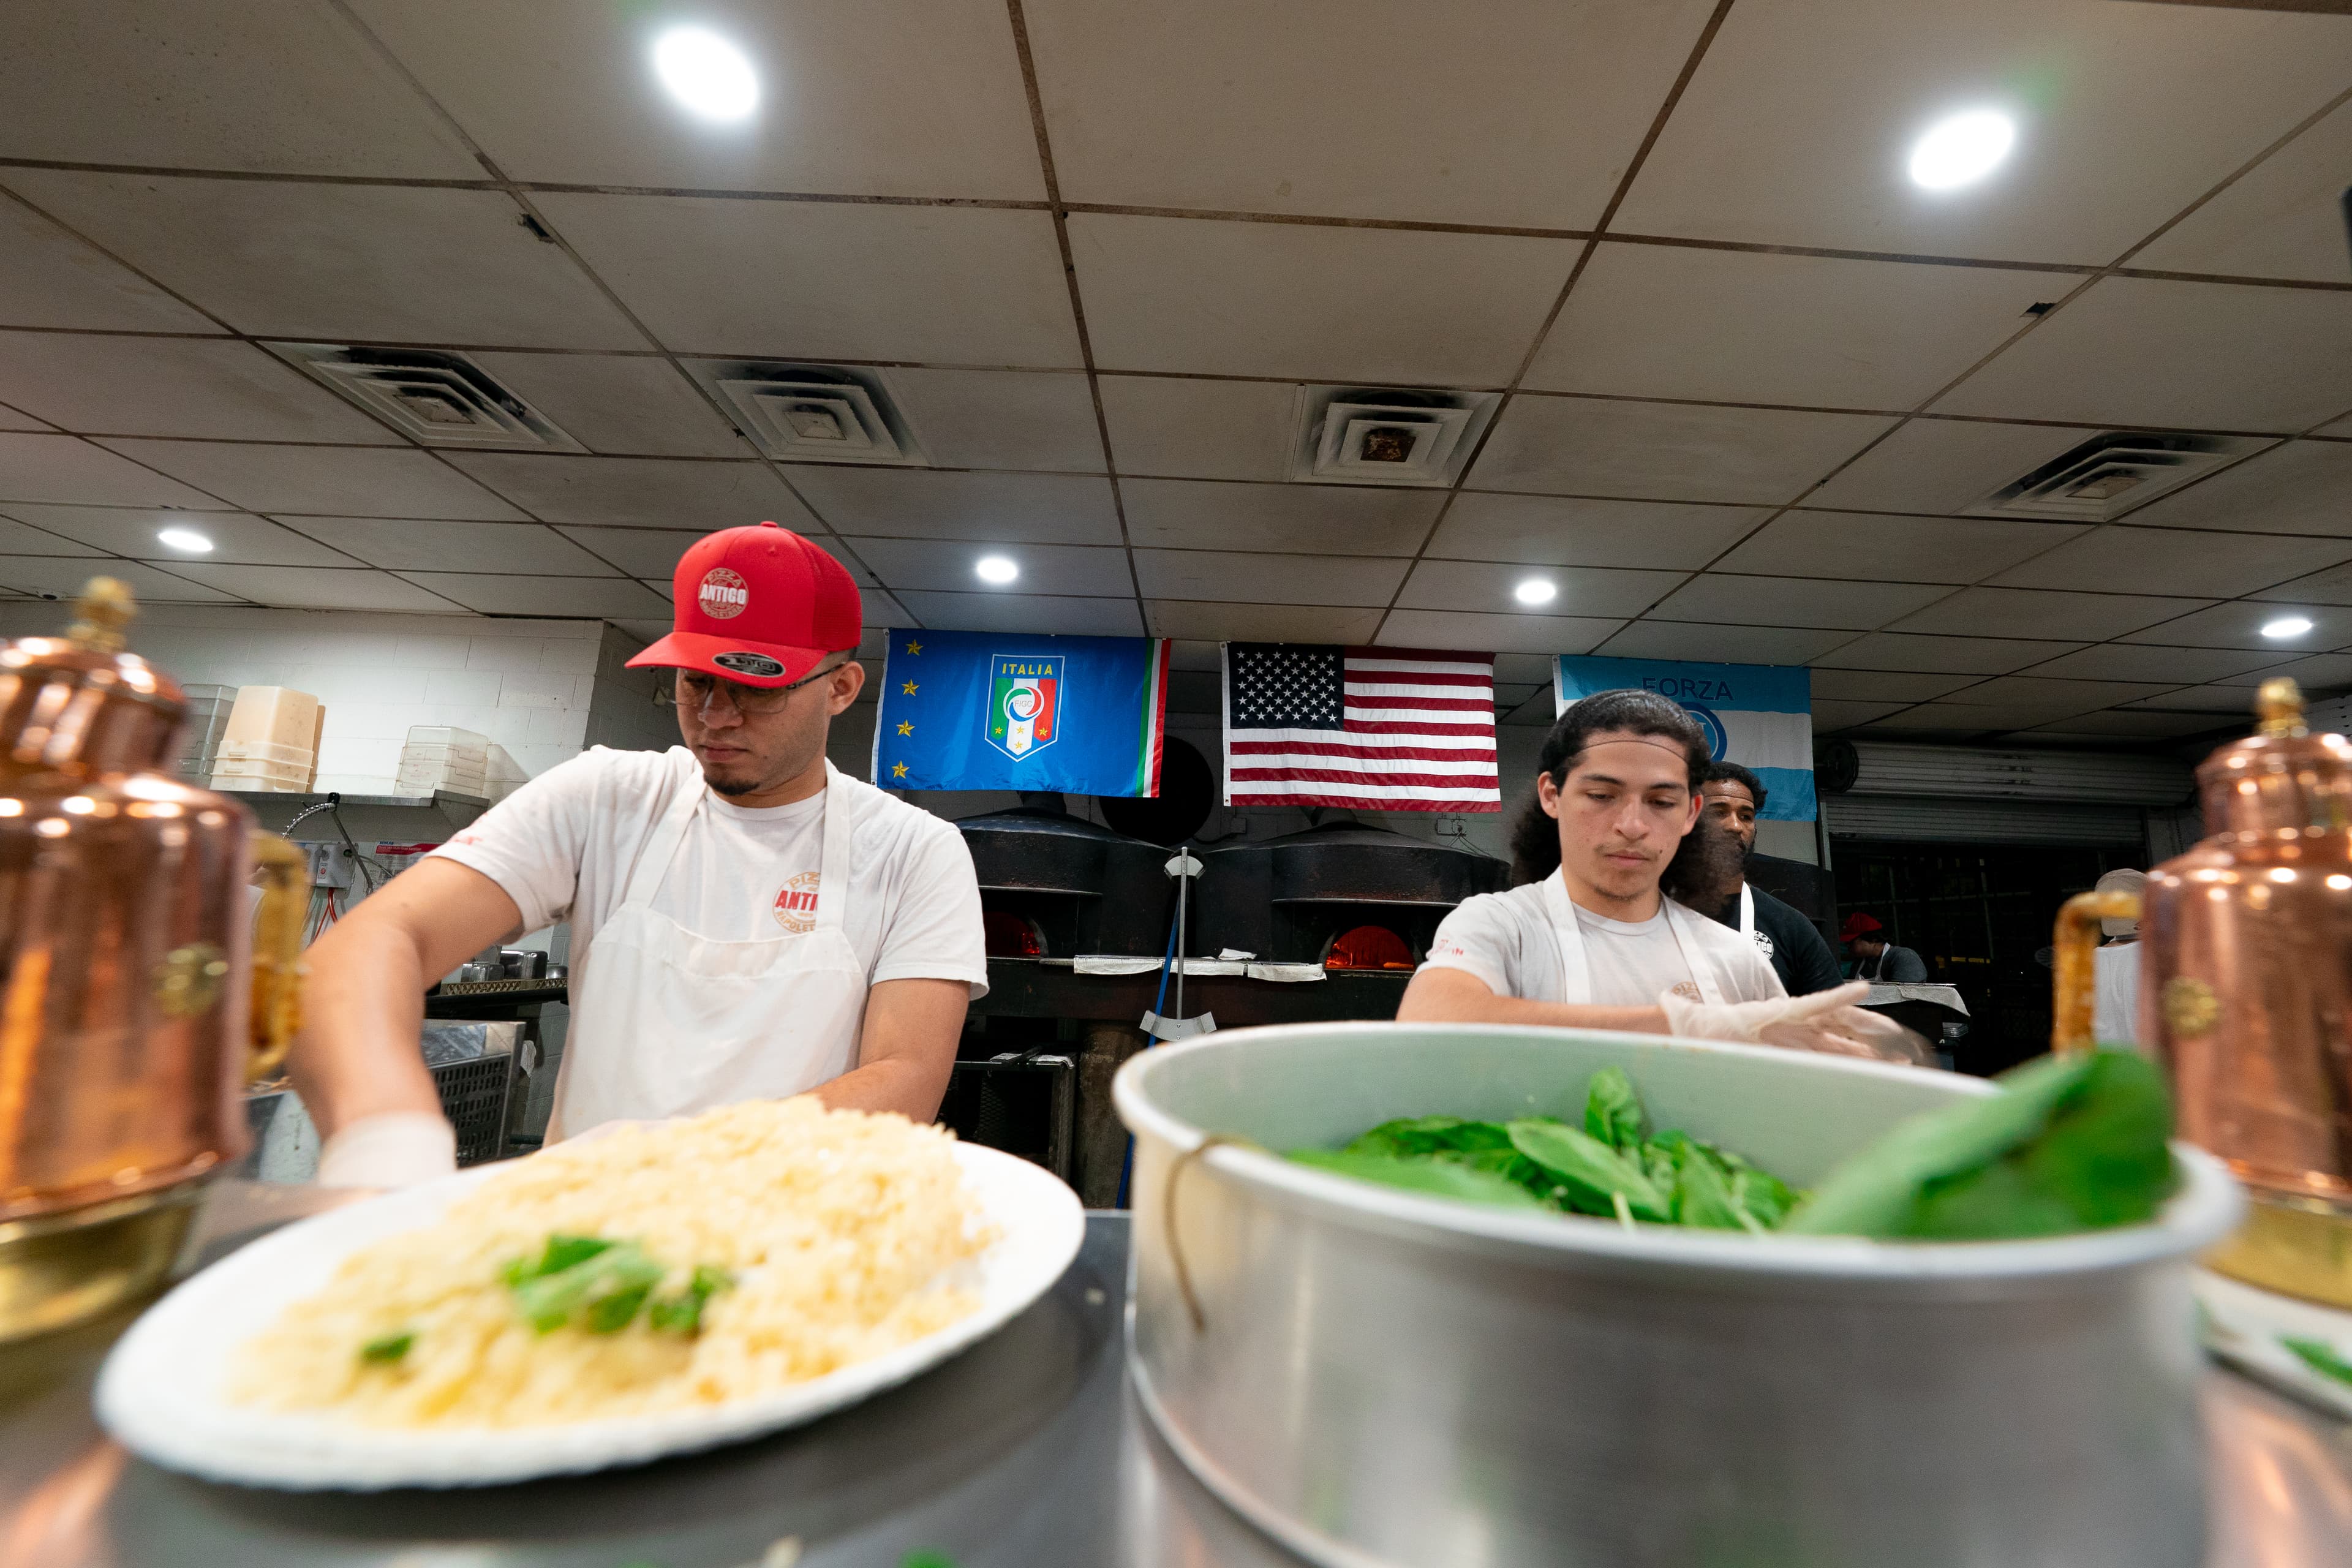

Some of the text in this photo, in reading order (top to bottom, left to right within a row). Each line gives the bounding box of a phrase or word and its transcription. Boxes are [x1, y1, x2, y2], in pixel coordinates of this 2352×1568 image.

[1002, 663, 1053, 675] ITALIA
[1643, 677, 1735, 701] FORZA
[775, 890, 818, 911] ANTI
[776, 910, 815, 932] NAPOLET
